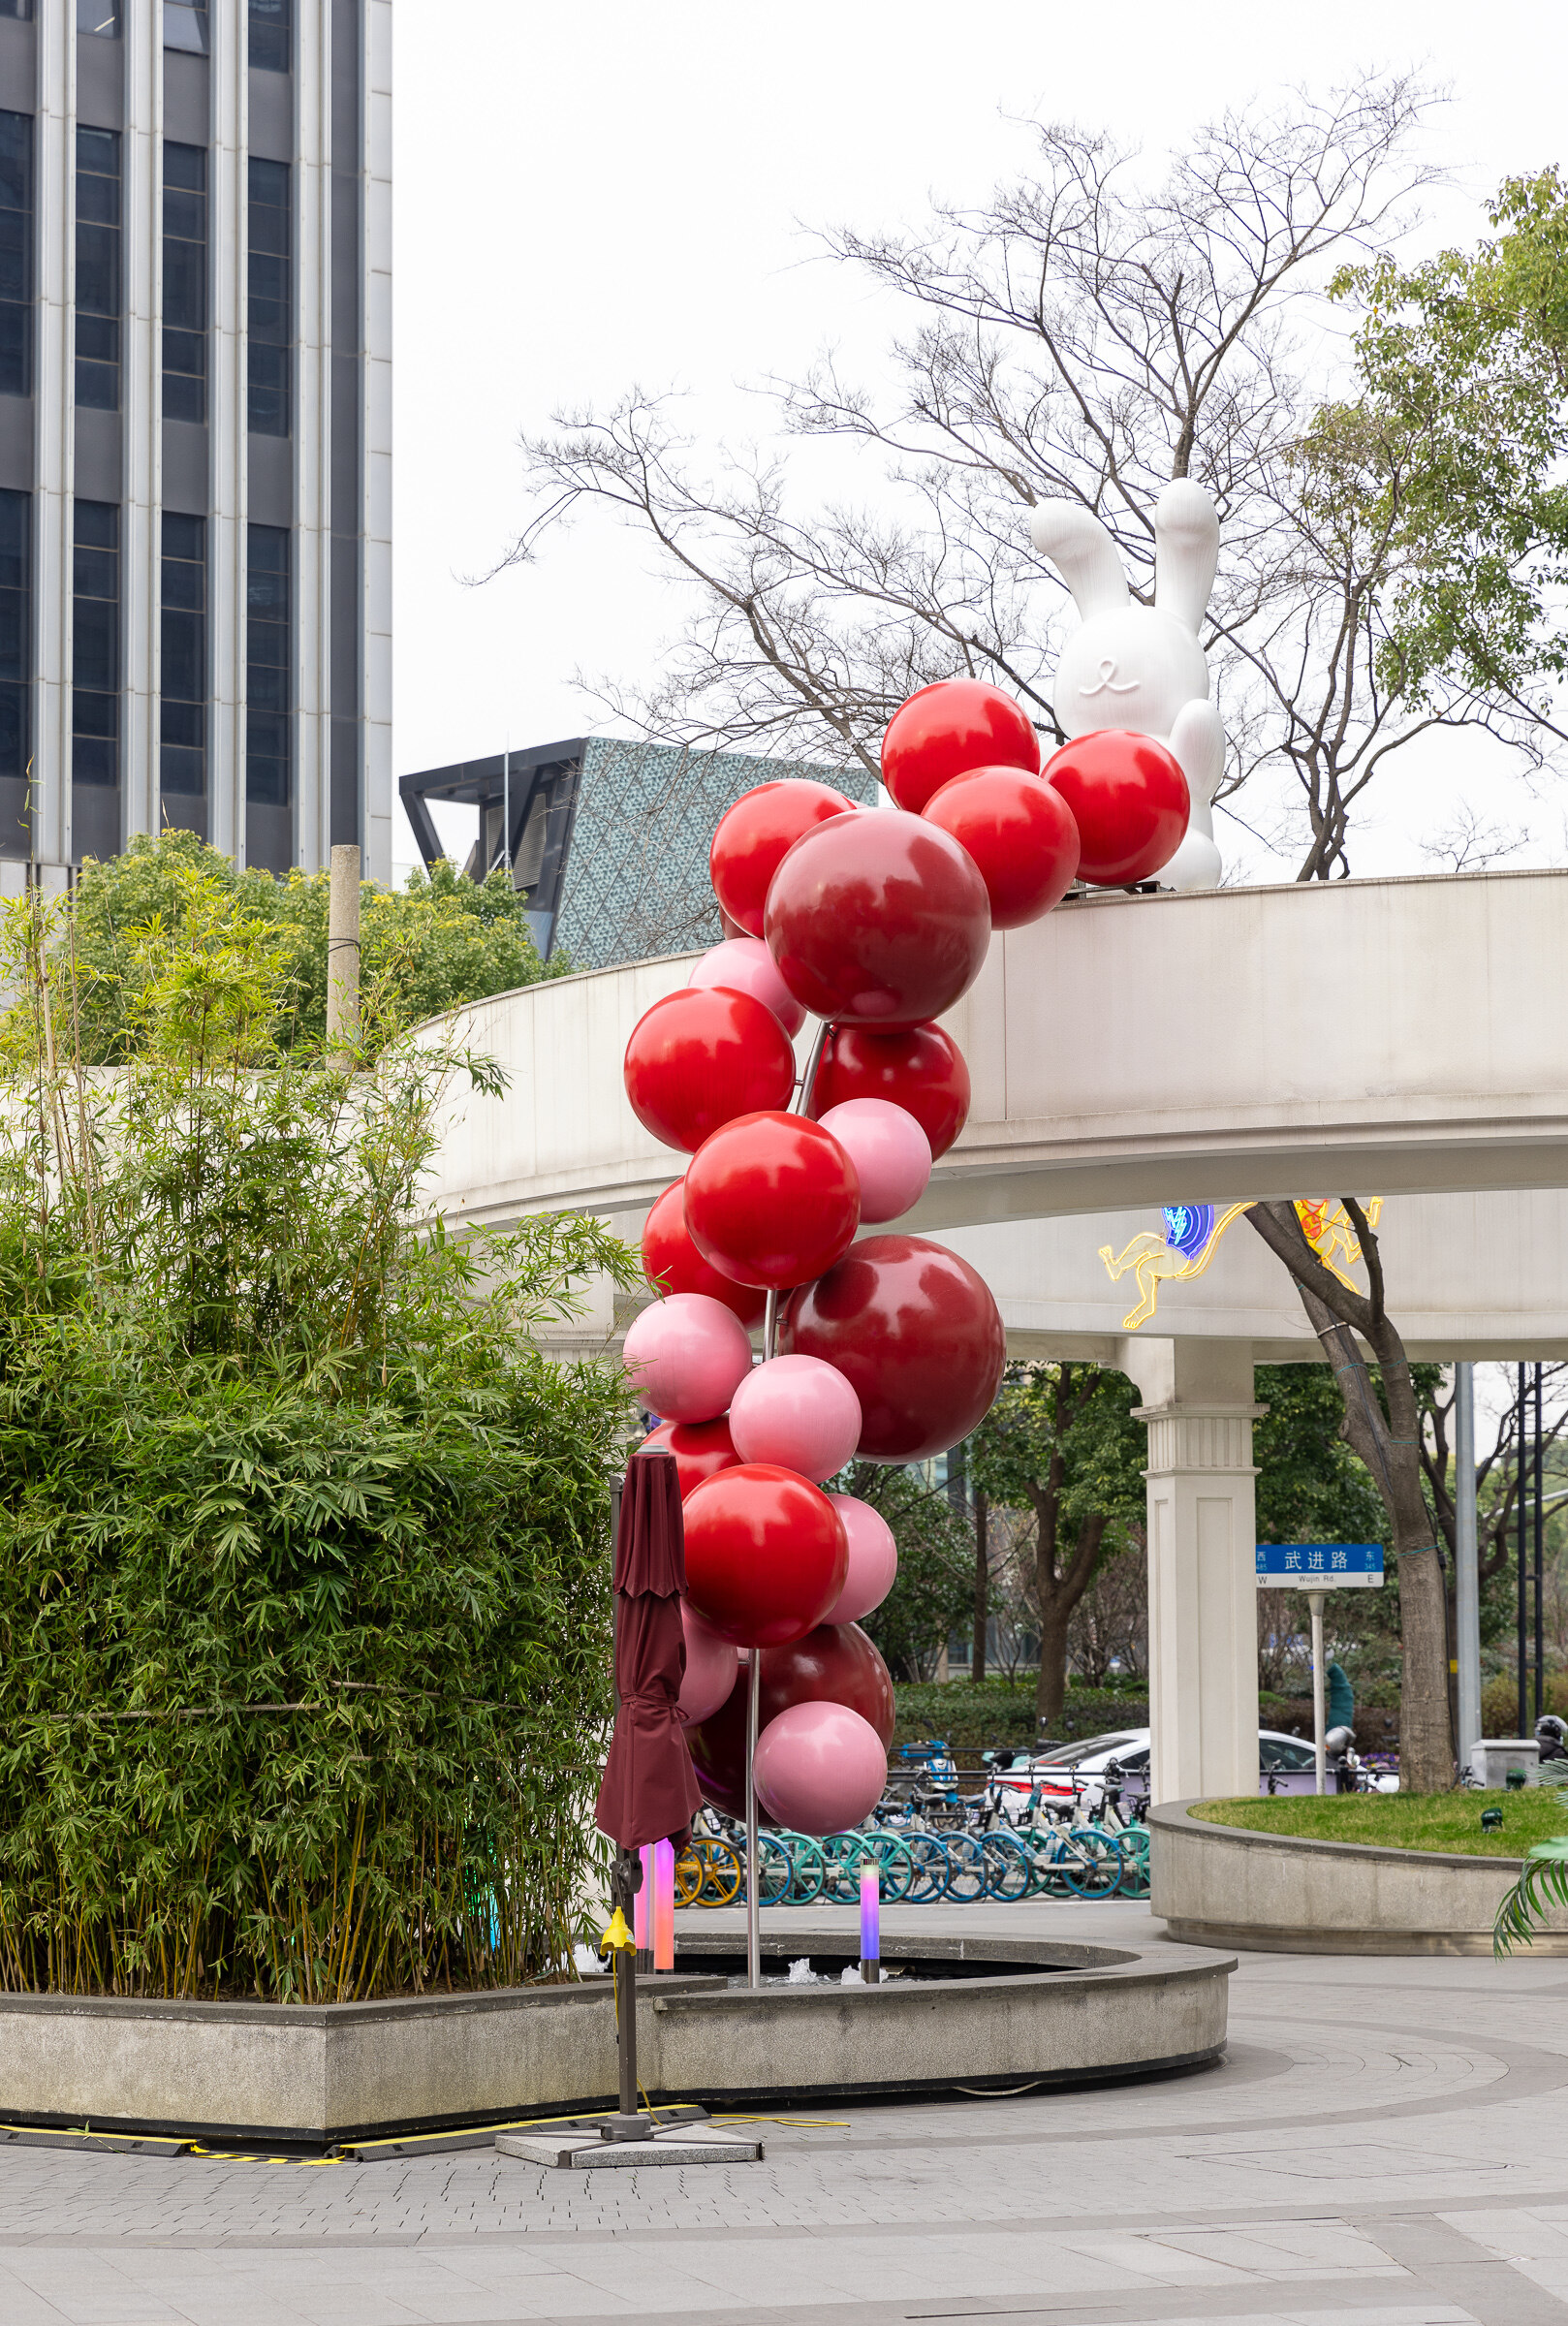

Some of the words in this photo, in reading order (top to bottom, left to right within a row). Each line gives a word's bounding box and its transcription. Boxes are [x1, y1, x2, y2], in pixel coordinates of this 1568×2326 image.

[1284, 1550, 1347, 1569] 武进路
[1299, 1575, 1320, 1584] Wujin
[1367, 1574, 1374, 1583] E
